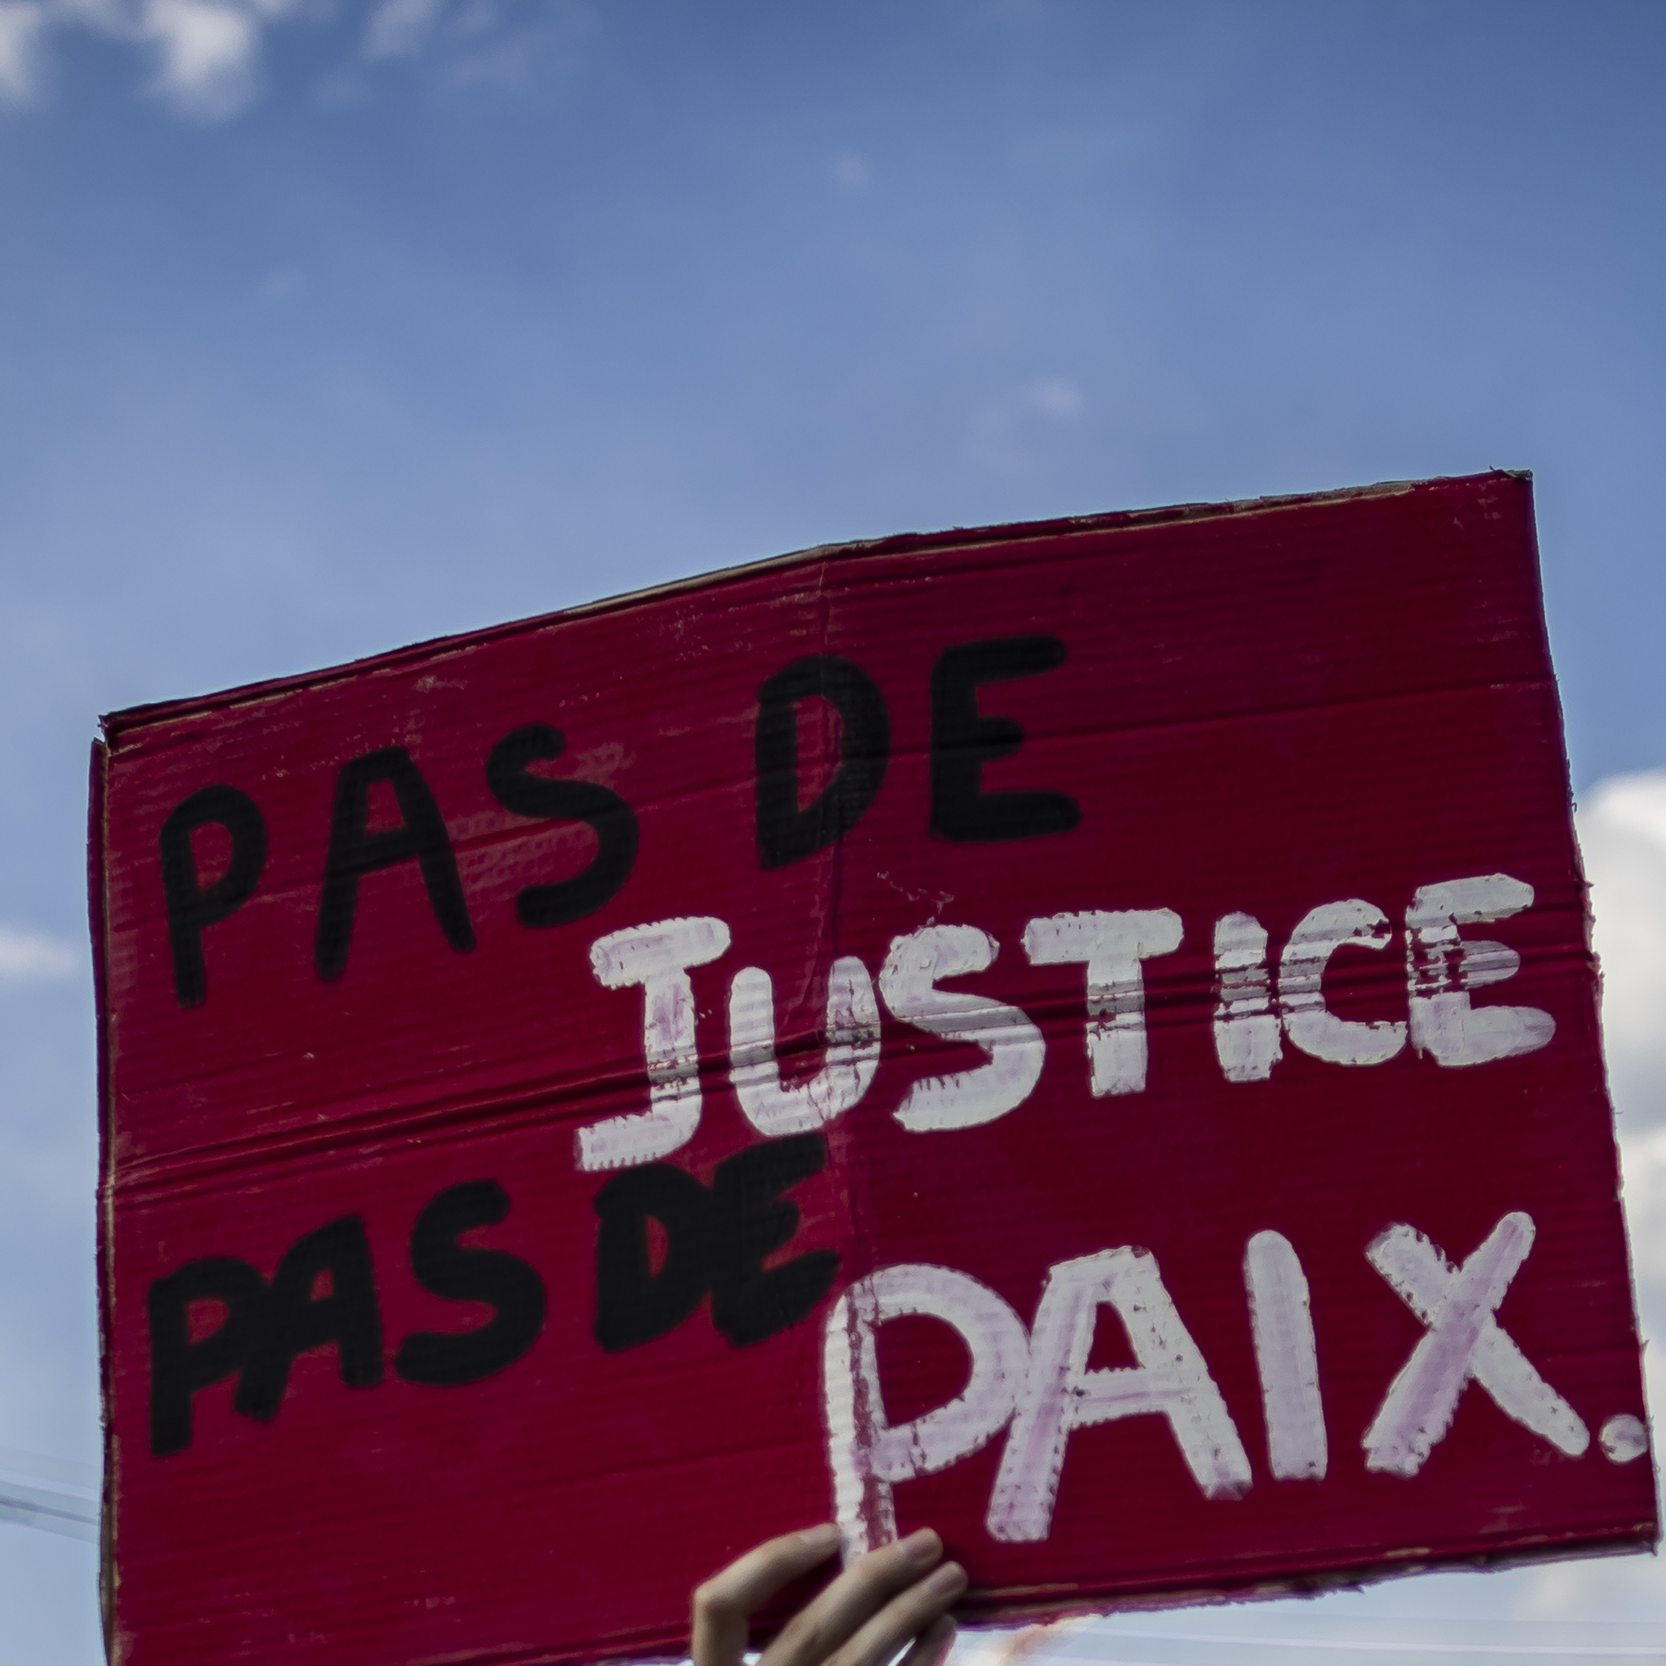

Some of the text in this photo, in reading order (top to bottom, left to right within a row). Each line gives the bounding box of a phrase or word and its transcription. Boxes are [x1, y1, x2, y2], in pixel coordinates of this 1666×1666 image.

[159, 634, 1083, 1008] PAS DE
[576, 872, 1557, 1172] JUSTICE
[147, 1130, 843, 1457] PAS DE
[824, 1210, 1649, 1560] PAIX.
